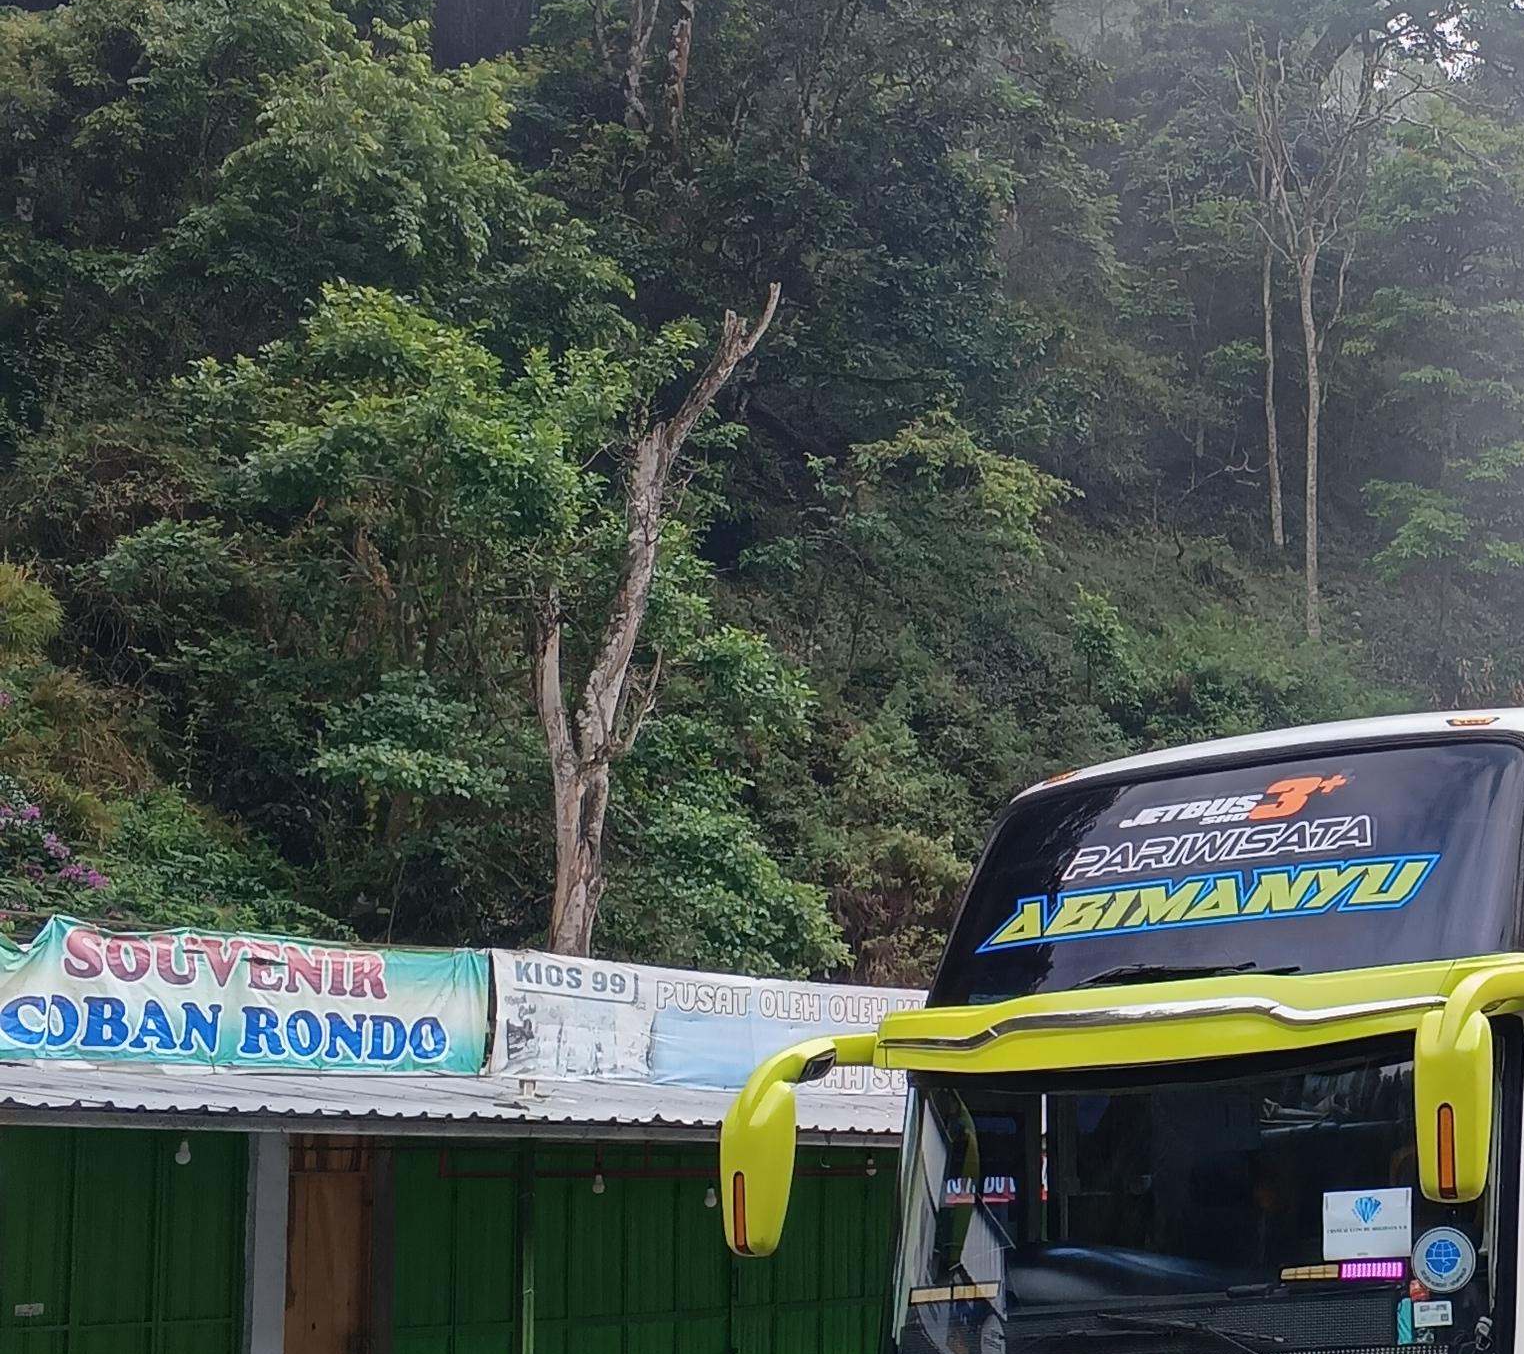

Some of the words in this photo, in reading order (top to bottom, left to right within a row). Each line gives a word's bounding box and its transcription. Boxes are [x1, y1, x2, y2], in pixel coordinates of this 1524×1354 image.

[1119, 793, 1263, 828] JETBUS
[1062, 815, 1373, 881] PARIWISATA
[984, 857, 1433, 949] ABIMANYU
[64, 927, 387, 1000] SOUVENIR
[514, 960, 583, 989] KIOS
[591, 971, 627, 995] 99
[1, 994, 222, 1053] COBAN
[240, 1003, 448, 1062] RONDO
[656, 980, 751, 1015] PUSAT
[760, 988, 822, 1022] OLEH
[828, 994, 889, 1025] OLEH
